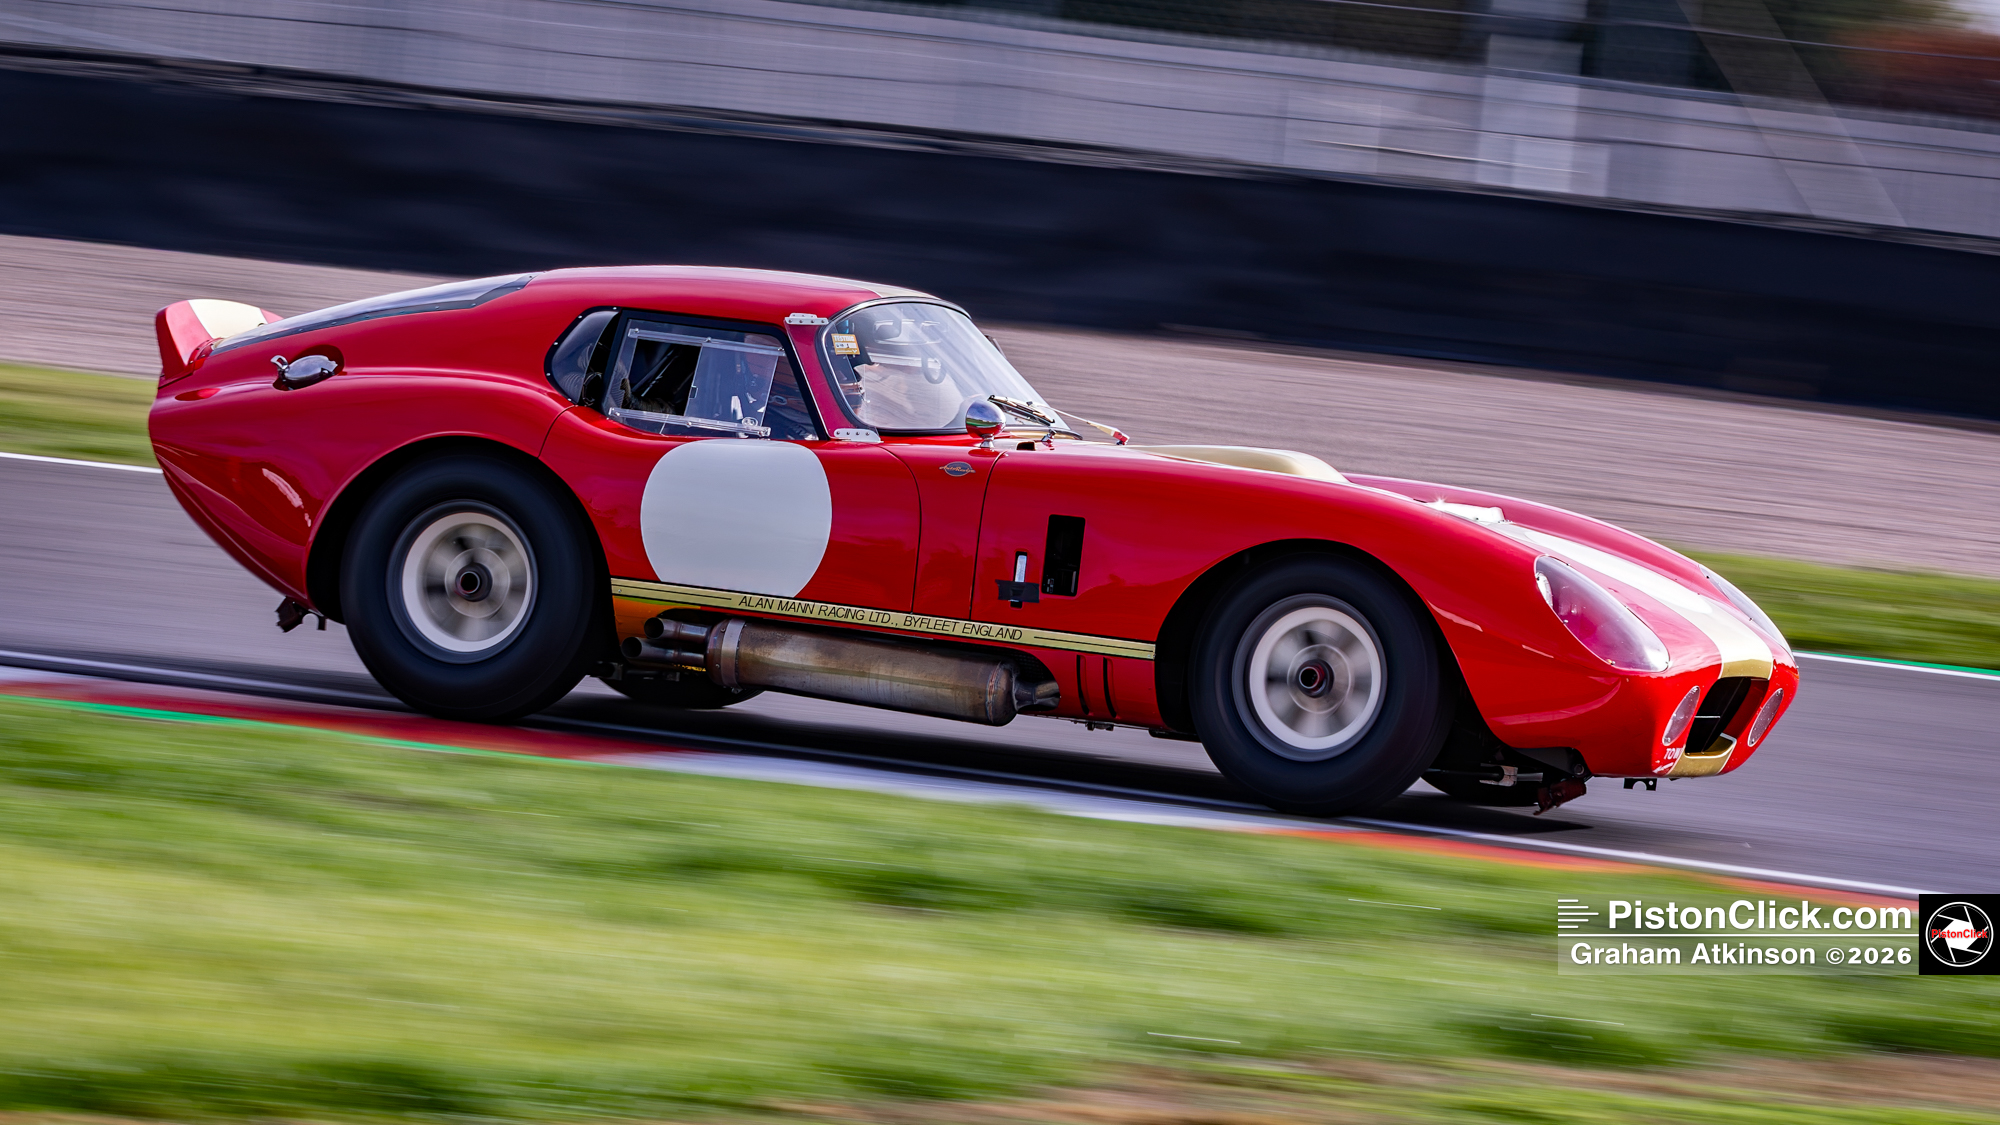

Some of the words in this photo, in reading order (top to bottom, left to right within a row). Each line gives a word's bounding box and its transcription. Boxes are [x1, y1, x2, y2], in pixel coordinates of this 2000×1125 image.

[738, 595, 775, 609] ALAN
[777, 600, 815, 615] MANN
[818, 604, 865, 621] RACING
[868, 611, 899, 627] LTD.,
[903, 615, 960, 632] BYFLEET
[961, 623, 1023, 641] ENGLAND
